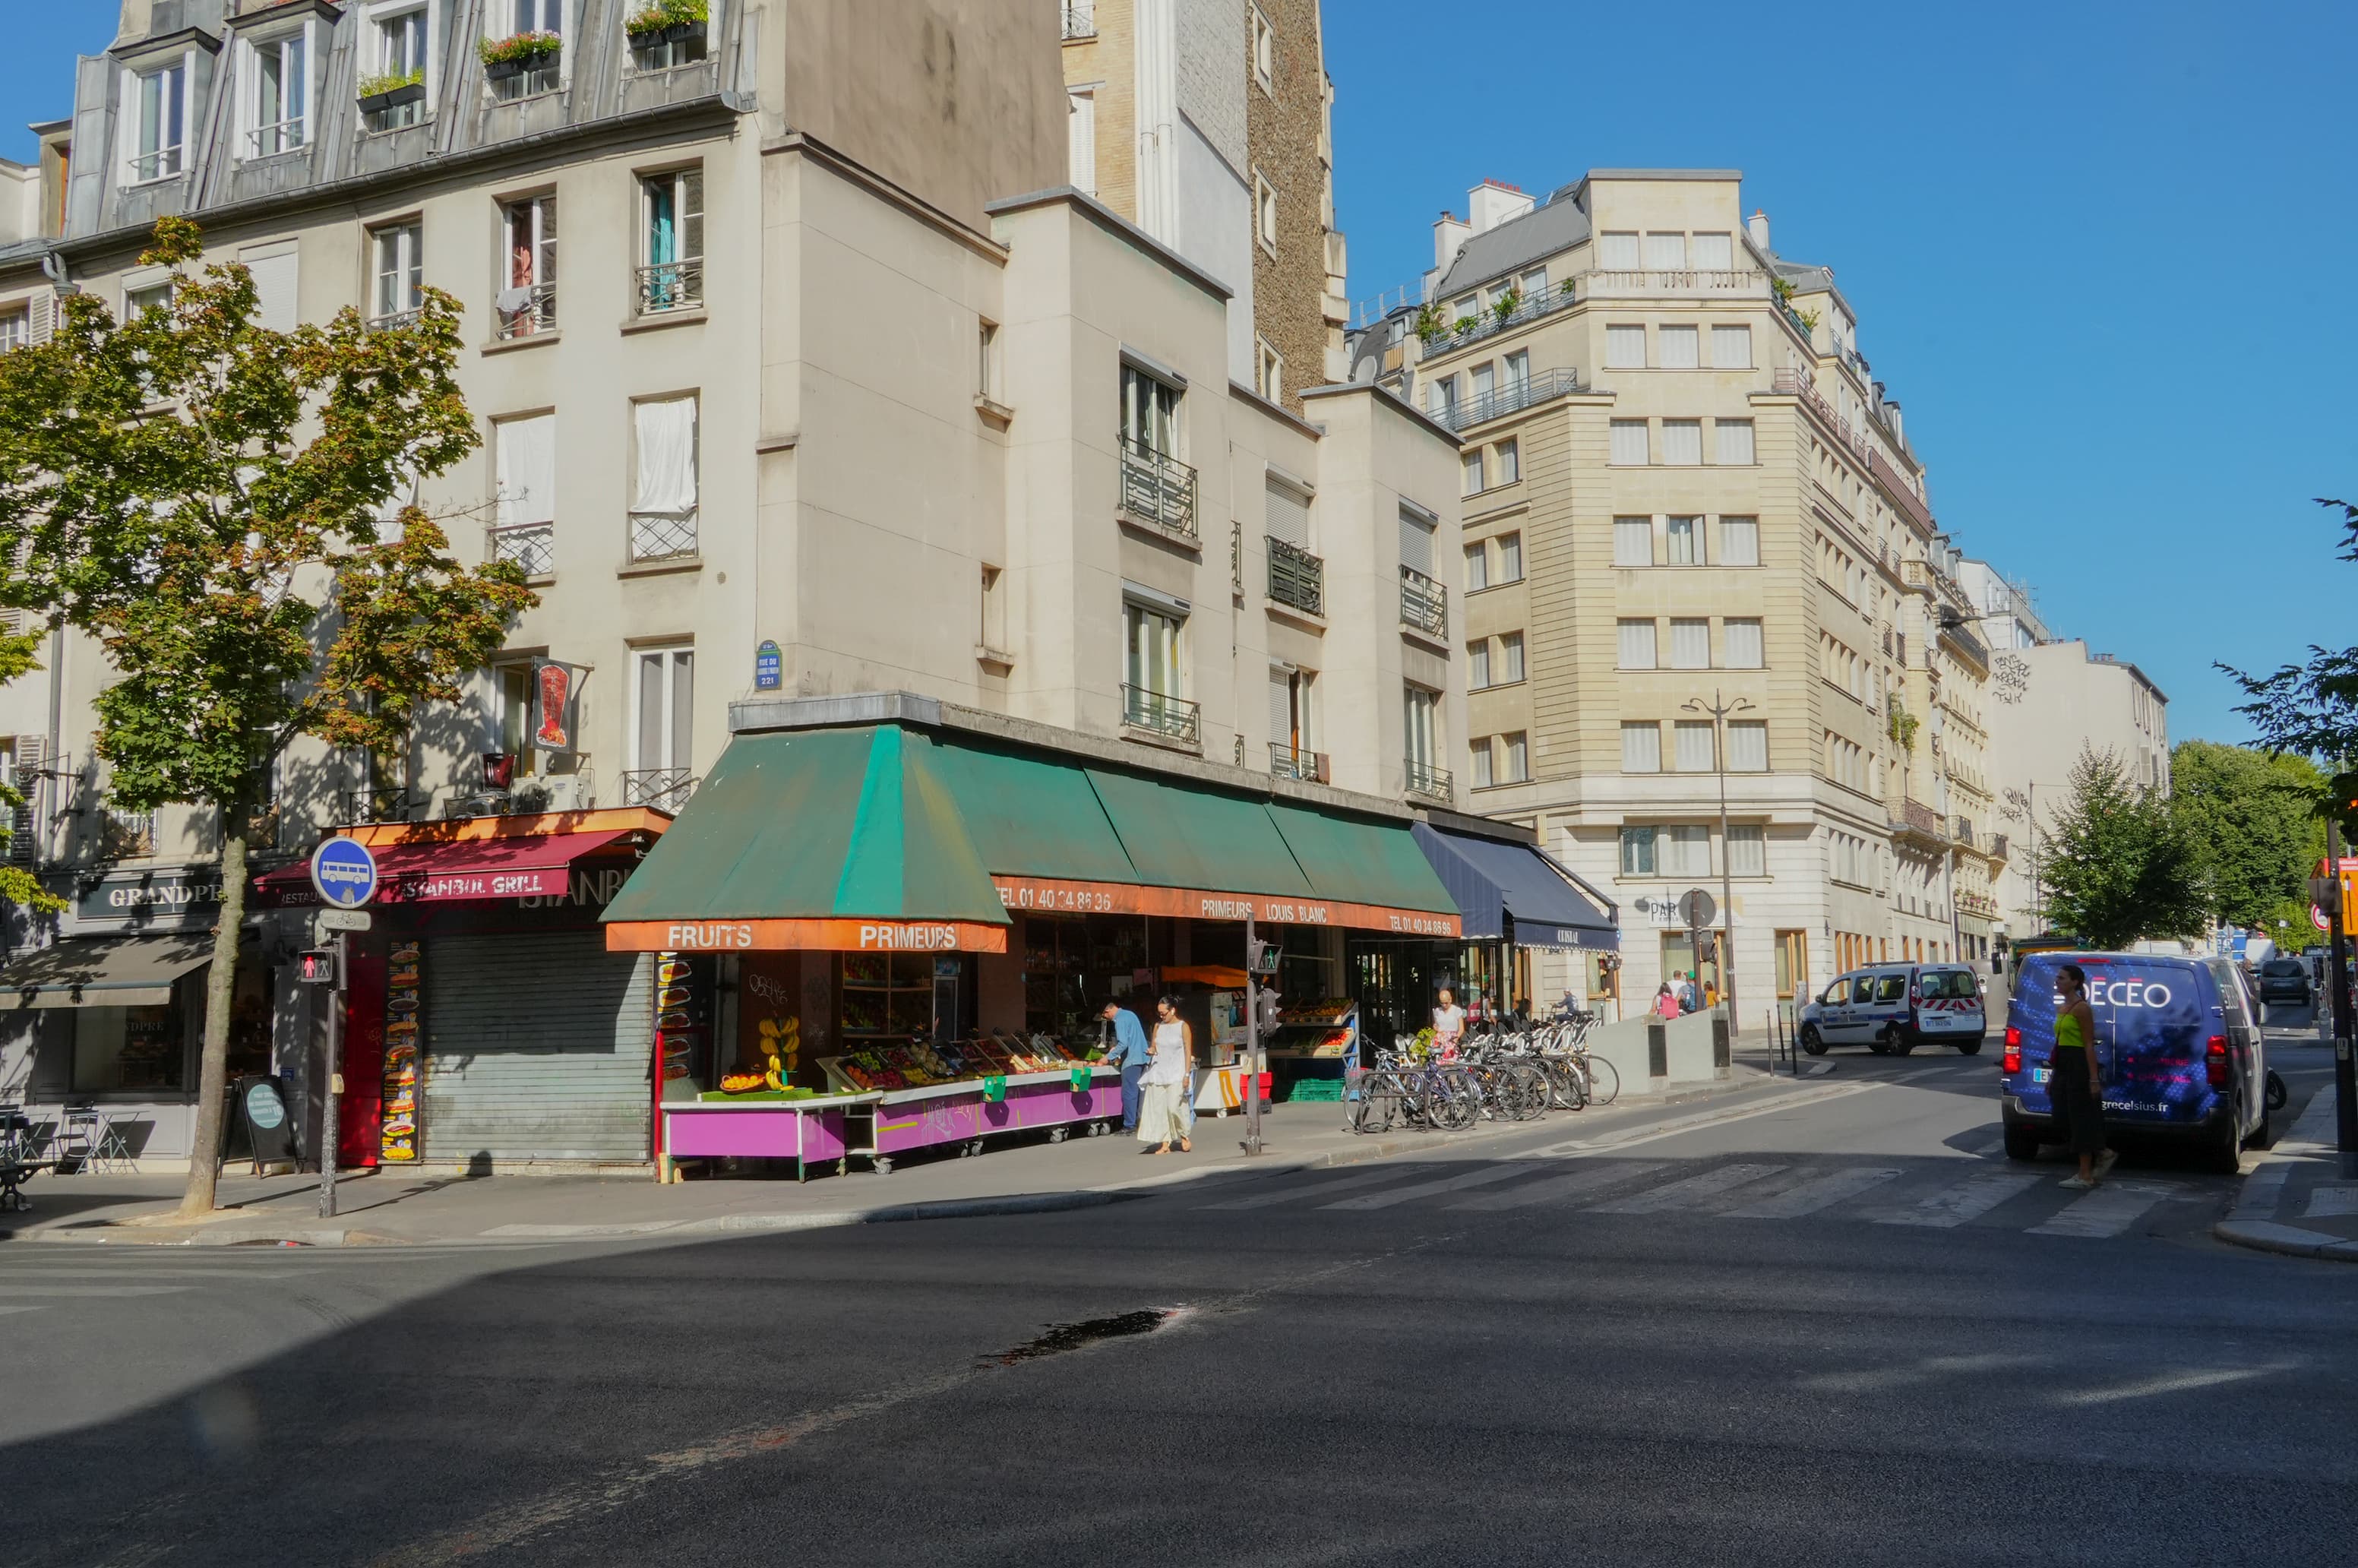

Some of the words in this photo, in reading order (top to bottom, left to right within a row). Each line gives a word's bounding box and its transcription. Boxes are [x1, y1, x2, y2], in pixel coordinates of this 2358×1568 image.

[492, 874, 542, 894] GRILL
[1019, 887, 1034, 907] 01
[1038, 889, 1054, 908] 40
[1077, 892, 1092, 910] 86
[1202, 899, 1252, 919] PRIMEURS
[1266, 903, 1294, 922] LOUIS
[1298, 906, 1326, 923] BLANC
[1389, 915, 1402, 931] TEL
[1403, 916, 1411, 931] 01
[1413, 918, 1422, 932] 40
[1423, 920, 1432, 934] 34
[1442, 922, 1451, 935] 96
[668, 925, 752, 947] FRUITS
[860, 925, 956, 949] PRIMEURS
